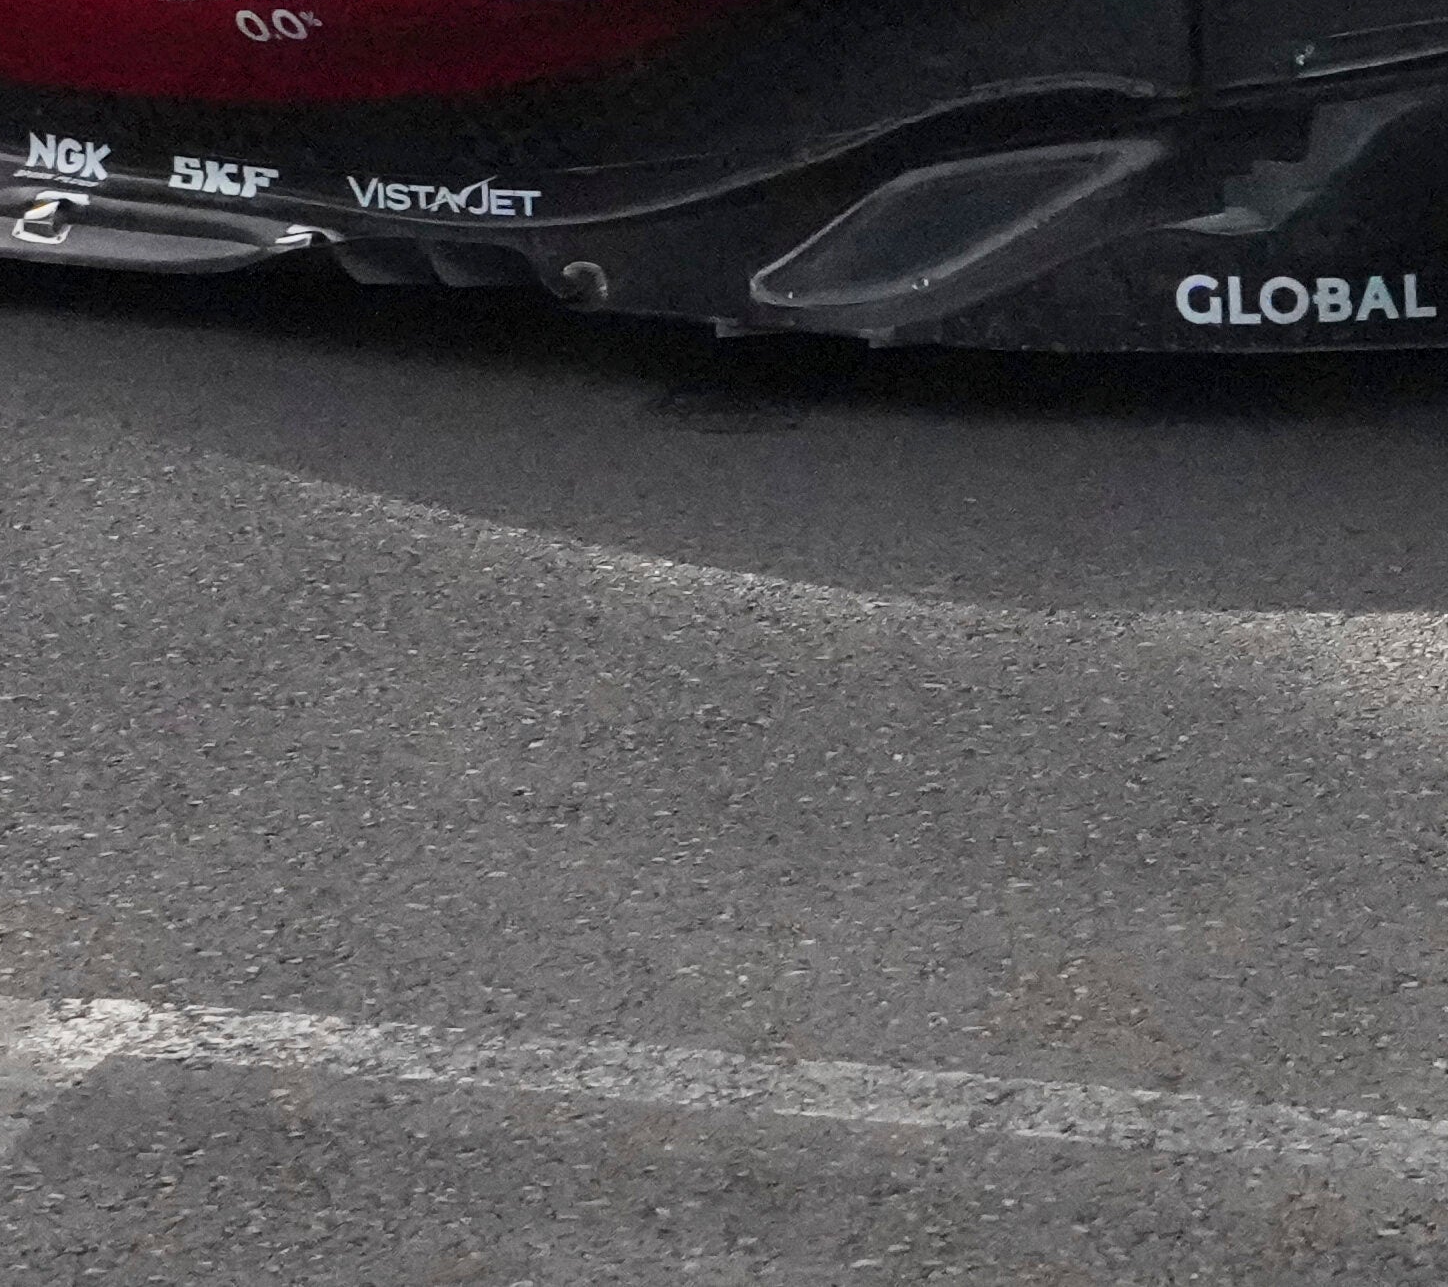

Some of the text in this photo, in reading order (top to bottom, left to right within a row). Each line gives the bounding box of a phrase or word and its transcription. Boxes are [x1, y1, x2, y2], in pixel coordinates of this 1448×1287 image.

[24, 131, 113, 181] NGK
[168, 155, 280, 198] SKF
[1175, 272, 1439, 328] GLOBAL
